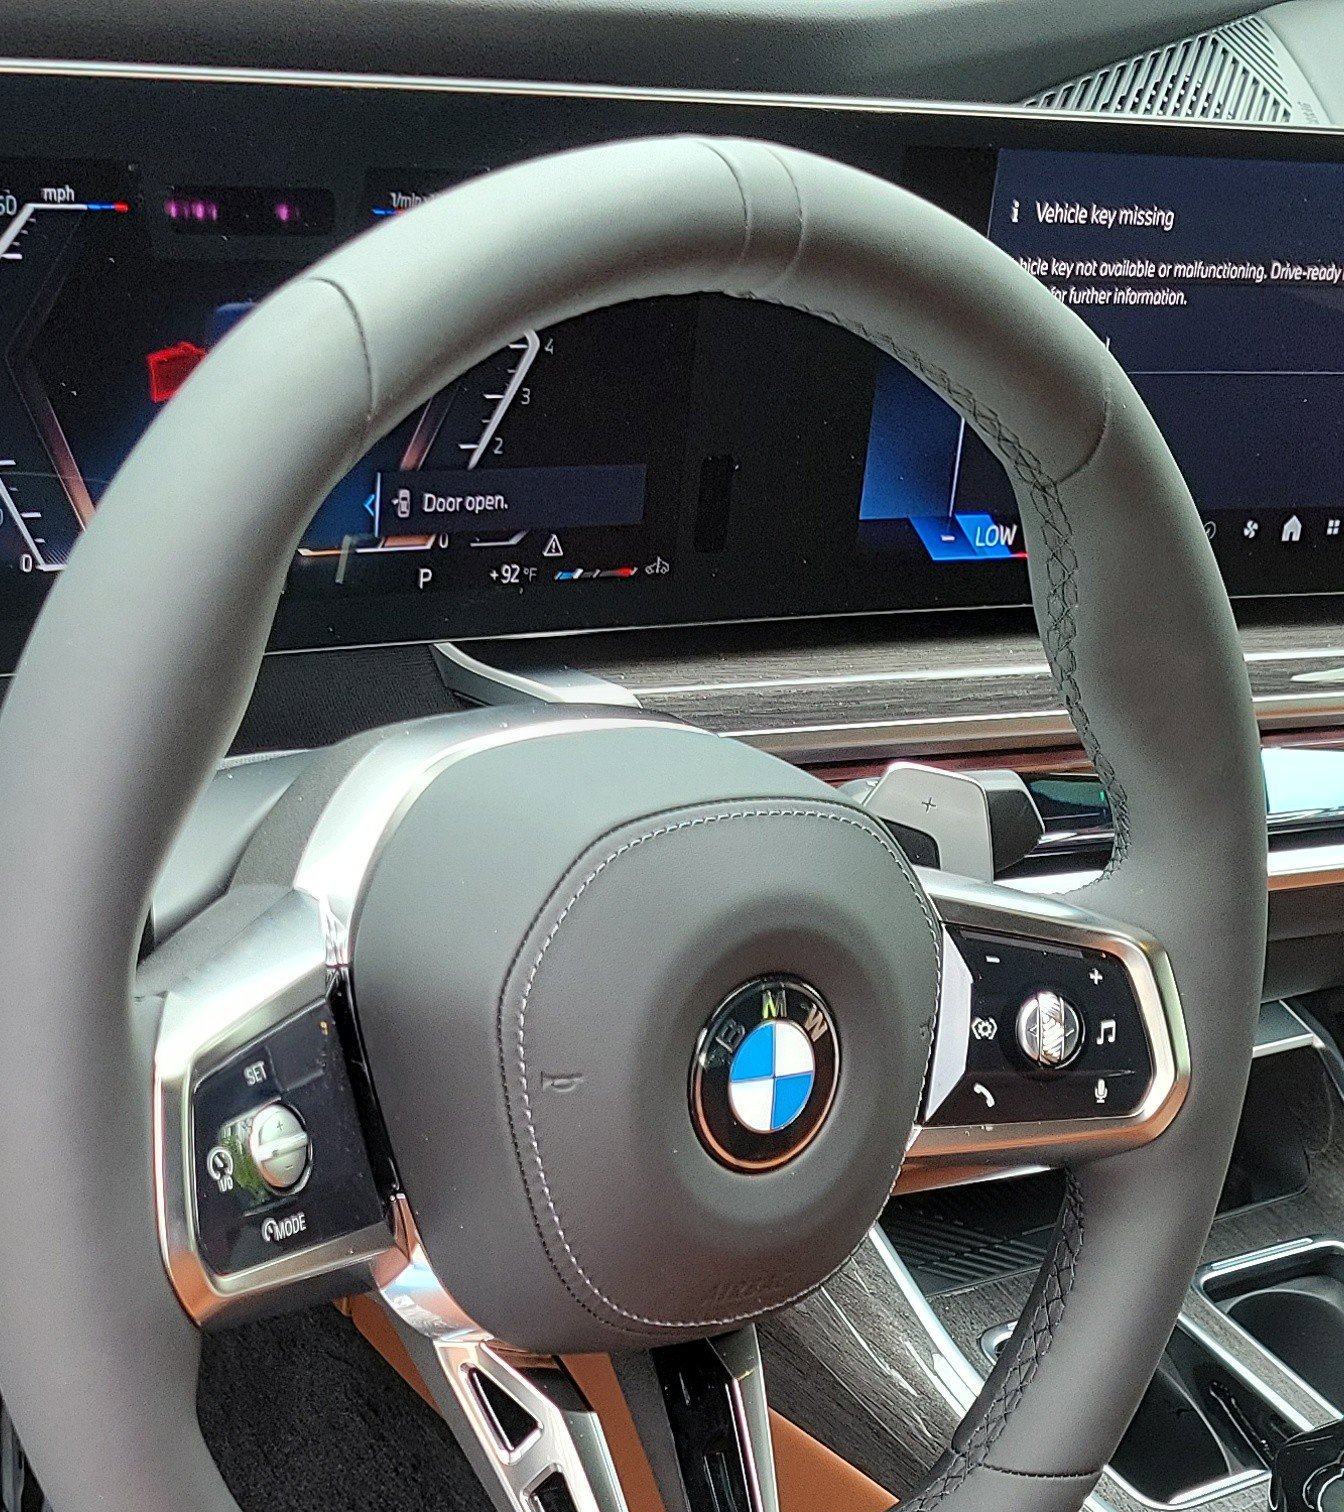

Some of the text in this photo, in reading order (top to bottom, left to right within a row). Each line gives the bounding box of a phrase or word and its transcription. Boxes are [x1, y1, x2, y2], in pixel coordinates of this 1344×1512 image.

[41, 185, 75, 203] mph
[1036, 201, 1175, 231] Vehicle key missing
[1051, 258, 1074, 279] key
[1075, 259, 1097, 277] not
[1099, 258, 1155, 278] available
[1158, 263, 1173, 278] or
[1173, 261, 1267, 283] malfunctioning.
[1270, 261, 1342, 284] Drive-ready
[1068, 287, 1112, 306] further
[1113, 287, 1188, 306] information.
[545, 338, 554, 355] 4
[521, 388, 531, 405] 3
[494, 437, 503, 454] 2
[423, 493, 508, 514] Door open.
[975, 525, 1017, 548] LOW
[22, 555, 33, 573] 0
[418, 568, 433, 590] P
[716, 989, 828, 1053] BMW
[244, 1060, 268, 1086] SET
[274, 1212, 307, 1242] MODE
